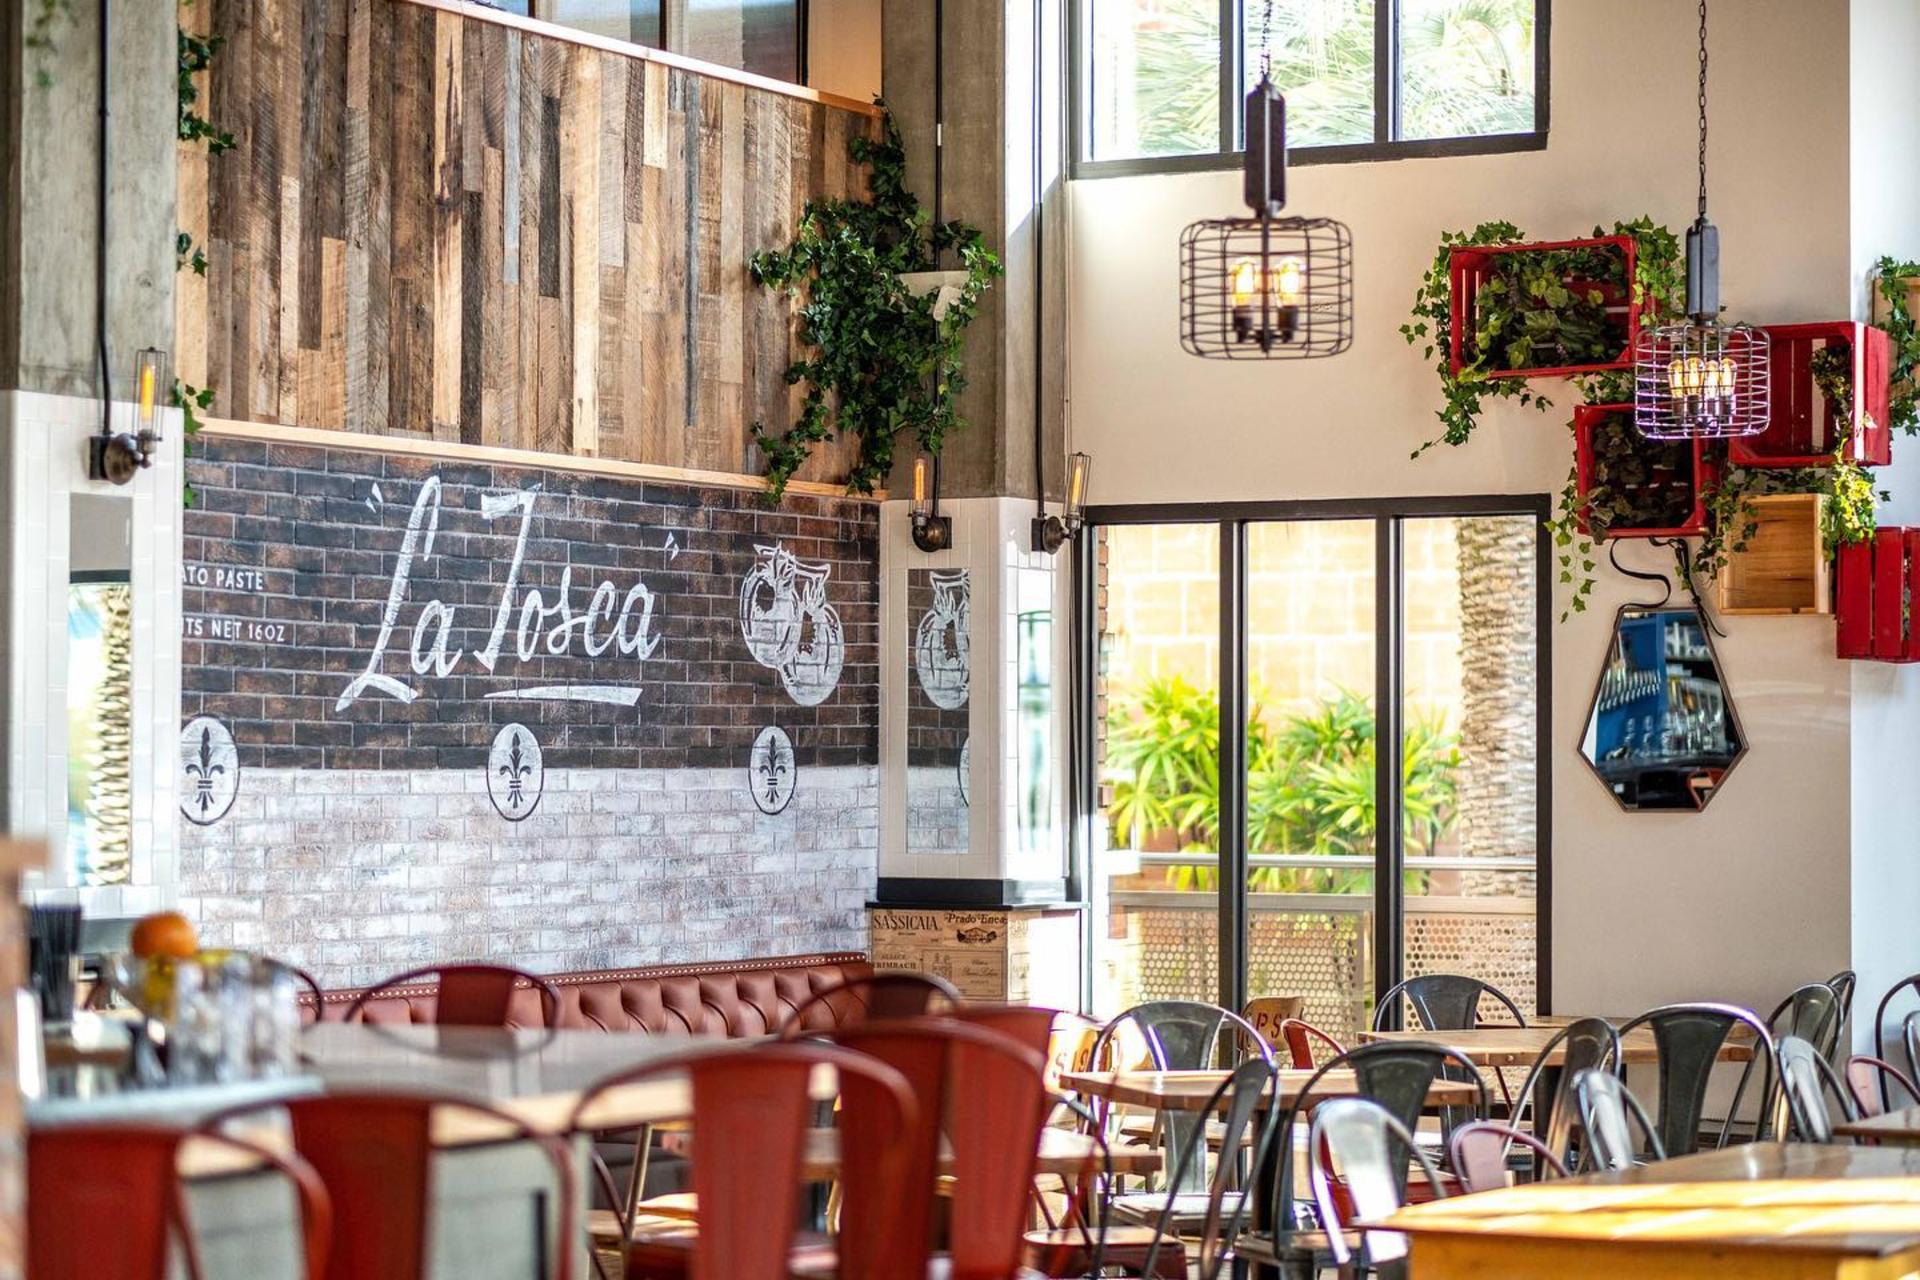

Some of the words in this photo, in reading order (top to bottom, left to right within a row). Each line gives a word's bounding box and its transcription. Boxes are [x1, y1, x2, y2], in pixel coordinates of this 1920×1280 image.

[216, 570, 264, 591] PASTE
[335, 476, 463, 712] La
[211, 619, 242, 639] NET
[874, 914, 938, 931] SASSICAIA
[946, 912, 977, 924] Prado
